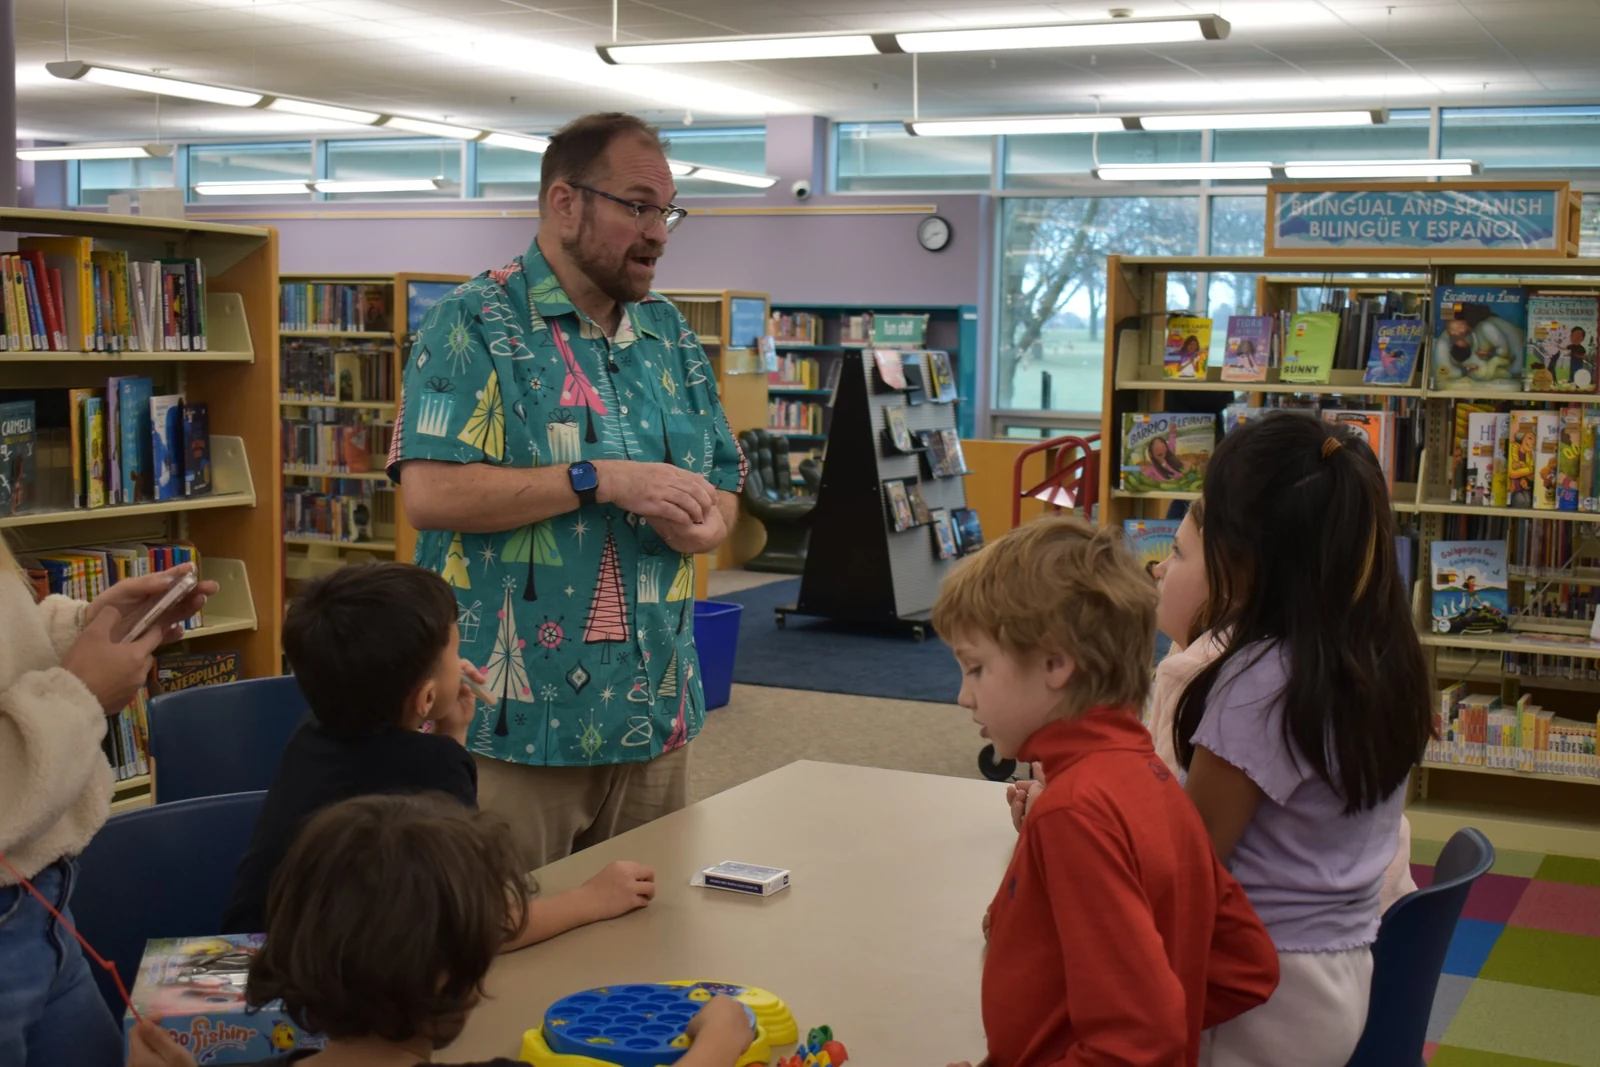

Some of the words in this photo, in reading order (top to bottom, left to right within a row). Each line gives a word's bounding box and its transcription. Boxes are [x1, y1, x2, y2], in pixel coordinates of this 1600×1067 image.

[1291, 198, 1395, 217] BILINGUAL
[1401, 198, 1448, 216] AND
[1454, 198, 1543, 215] SPANISH
[1309, 217, 1402, 237] BILINGÜE
[1408, 220, 1419, 237] Y
[1427, 215, 1520, 238] ESPAÑOL
[1284, 366, 1319, 374] SUNNY
[1, 416, 33, 437] CARMELA
[1130, 419, 1168, 446] BARRIO
[163, 658, 236, 693] CATERPILLAR
